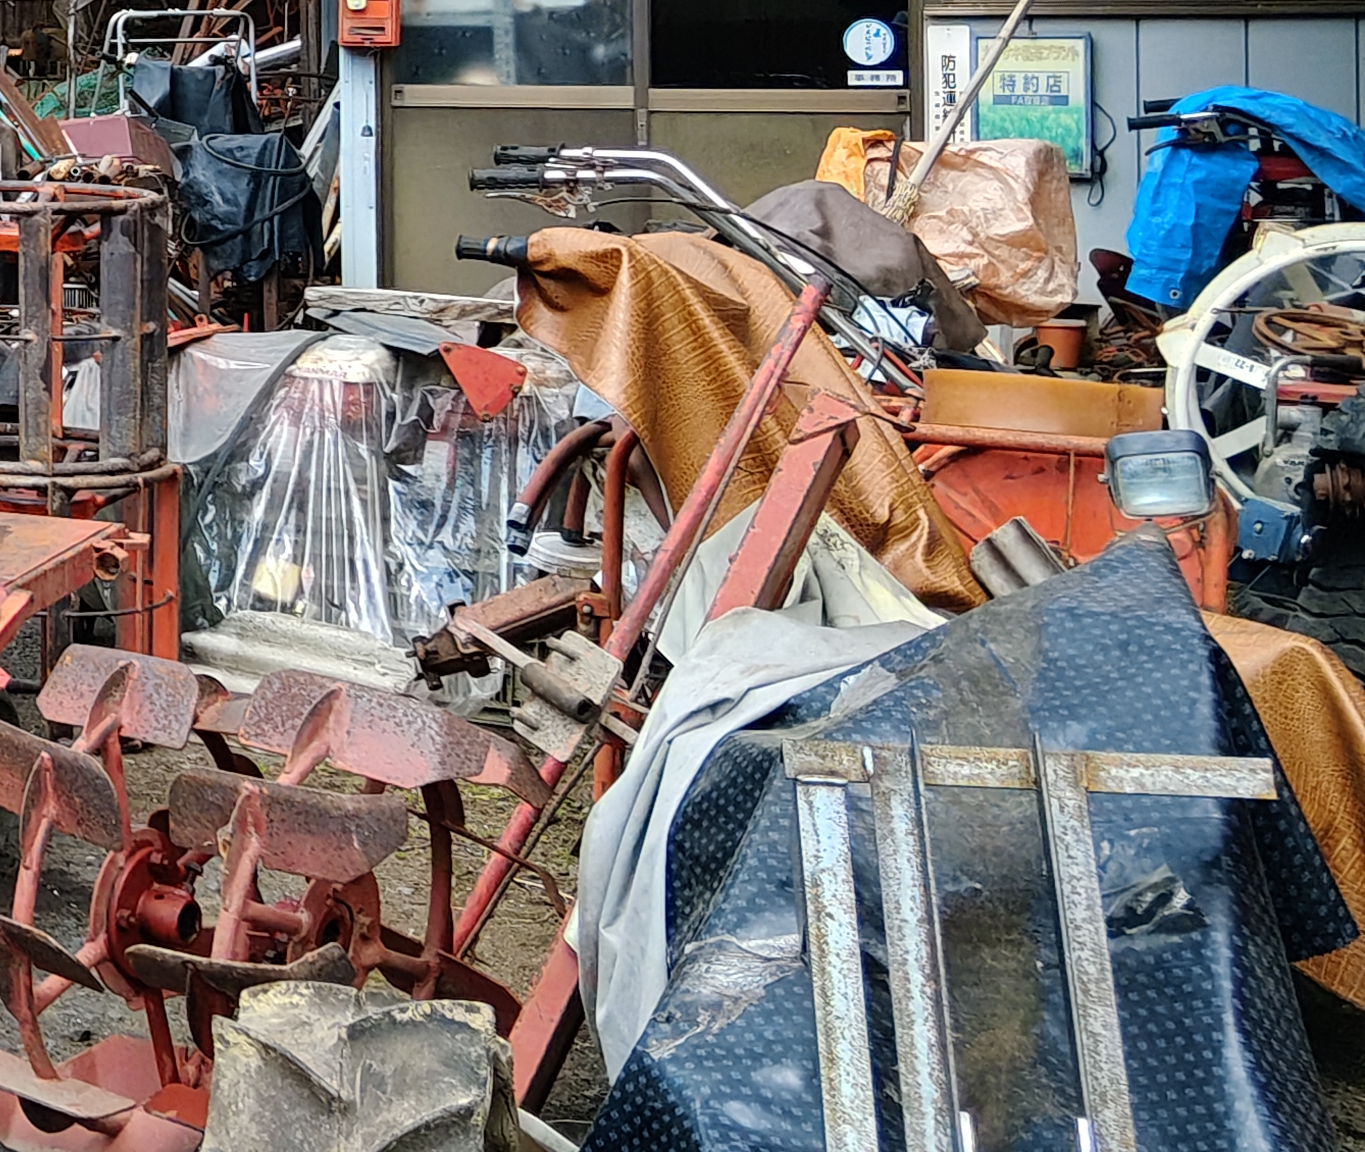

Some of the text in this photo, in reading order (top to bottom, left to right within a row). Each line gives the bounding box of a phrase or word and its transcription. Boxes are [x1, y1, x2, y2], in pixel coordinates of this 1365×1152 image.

[940, 53, 957, 145] 防犯連
[998, 72, 1063, 94] 特約店
